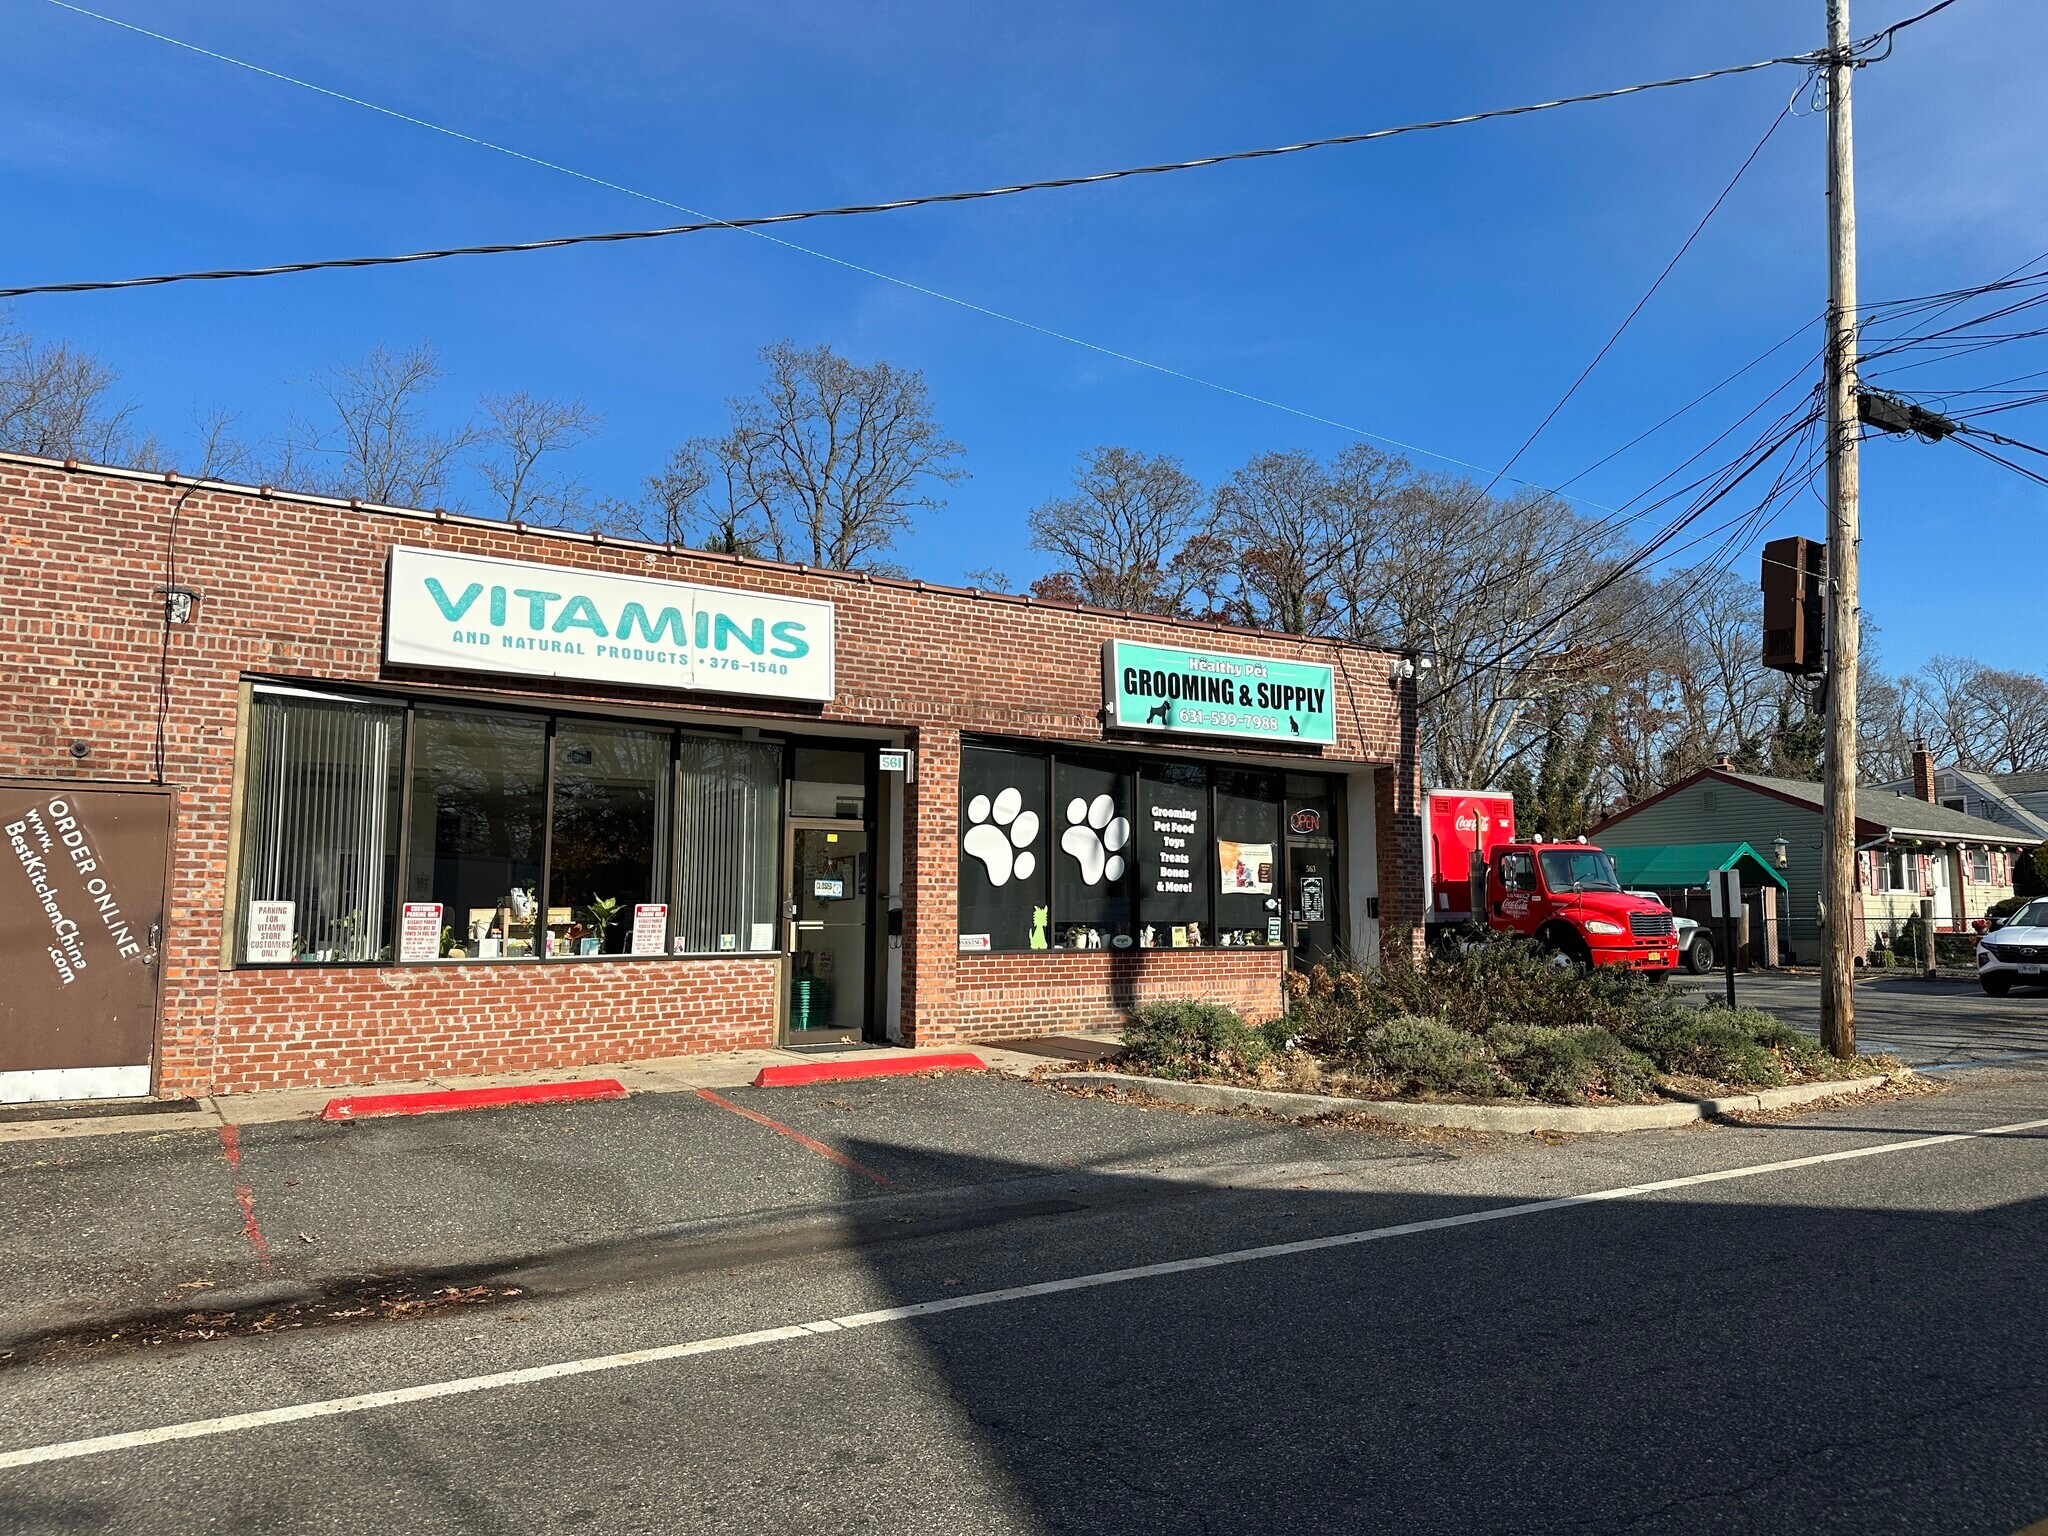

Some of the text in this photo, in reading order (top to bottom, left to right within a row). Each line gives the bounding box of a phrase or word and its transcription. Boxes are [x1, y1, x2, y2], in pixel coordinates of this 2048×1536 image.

[424, 577, 810, 659] VITAMINS
[453, 630, 789, 676] AND NATURAL PRODUCTS 376-1540
[1189, 657, 1269, 679] Healthy Pet
[1124, 667, 1326, 714] GROOMING & SUPPLY
[1179, 708, 1279, 731] 631-539-7988
[882, 756, 902, 769] 561
[1151, 806, 1197, 821] Grooming
[1153, 821, 1195, 834] Pet Food
[1291, 813, 1319, 830] OPEN
[26, 808, 54, 854] www.
[1163, 836, 1185, 849] Toys
[1160, 851, 1190, 864] Treats
[1160, 866, 1190, 878] Bones
[48, 800, 140, 959] ORDER ONLINE
[1156, 881, 1193, 893] & More!
[5, 820, 87, 969] BestKitchenChina
[258, 906, 287, 914] PARKING
[266, 915, 278, 923] FOR
[260, 932, 281, 940] STORE
[250, 941, 291, 949] CUSTOMERS
[261, 949, 279, 957] ONLY
[47, 946, 75, 985] .com
